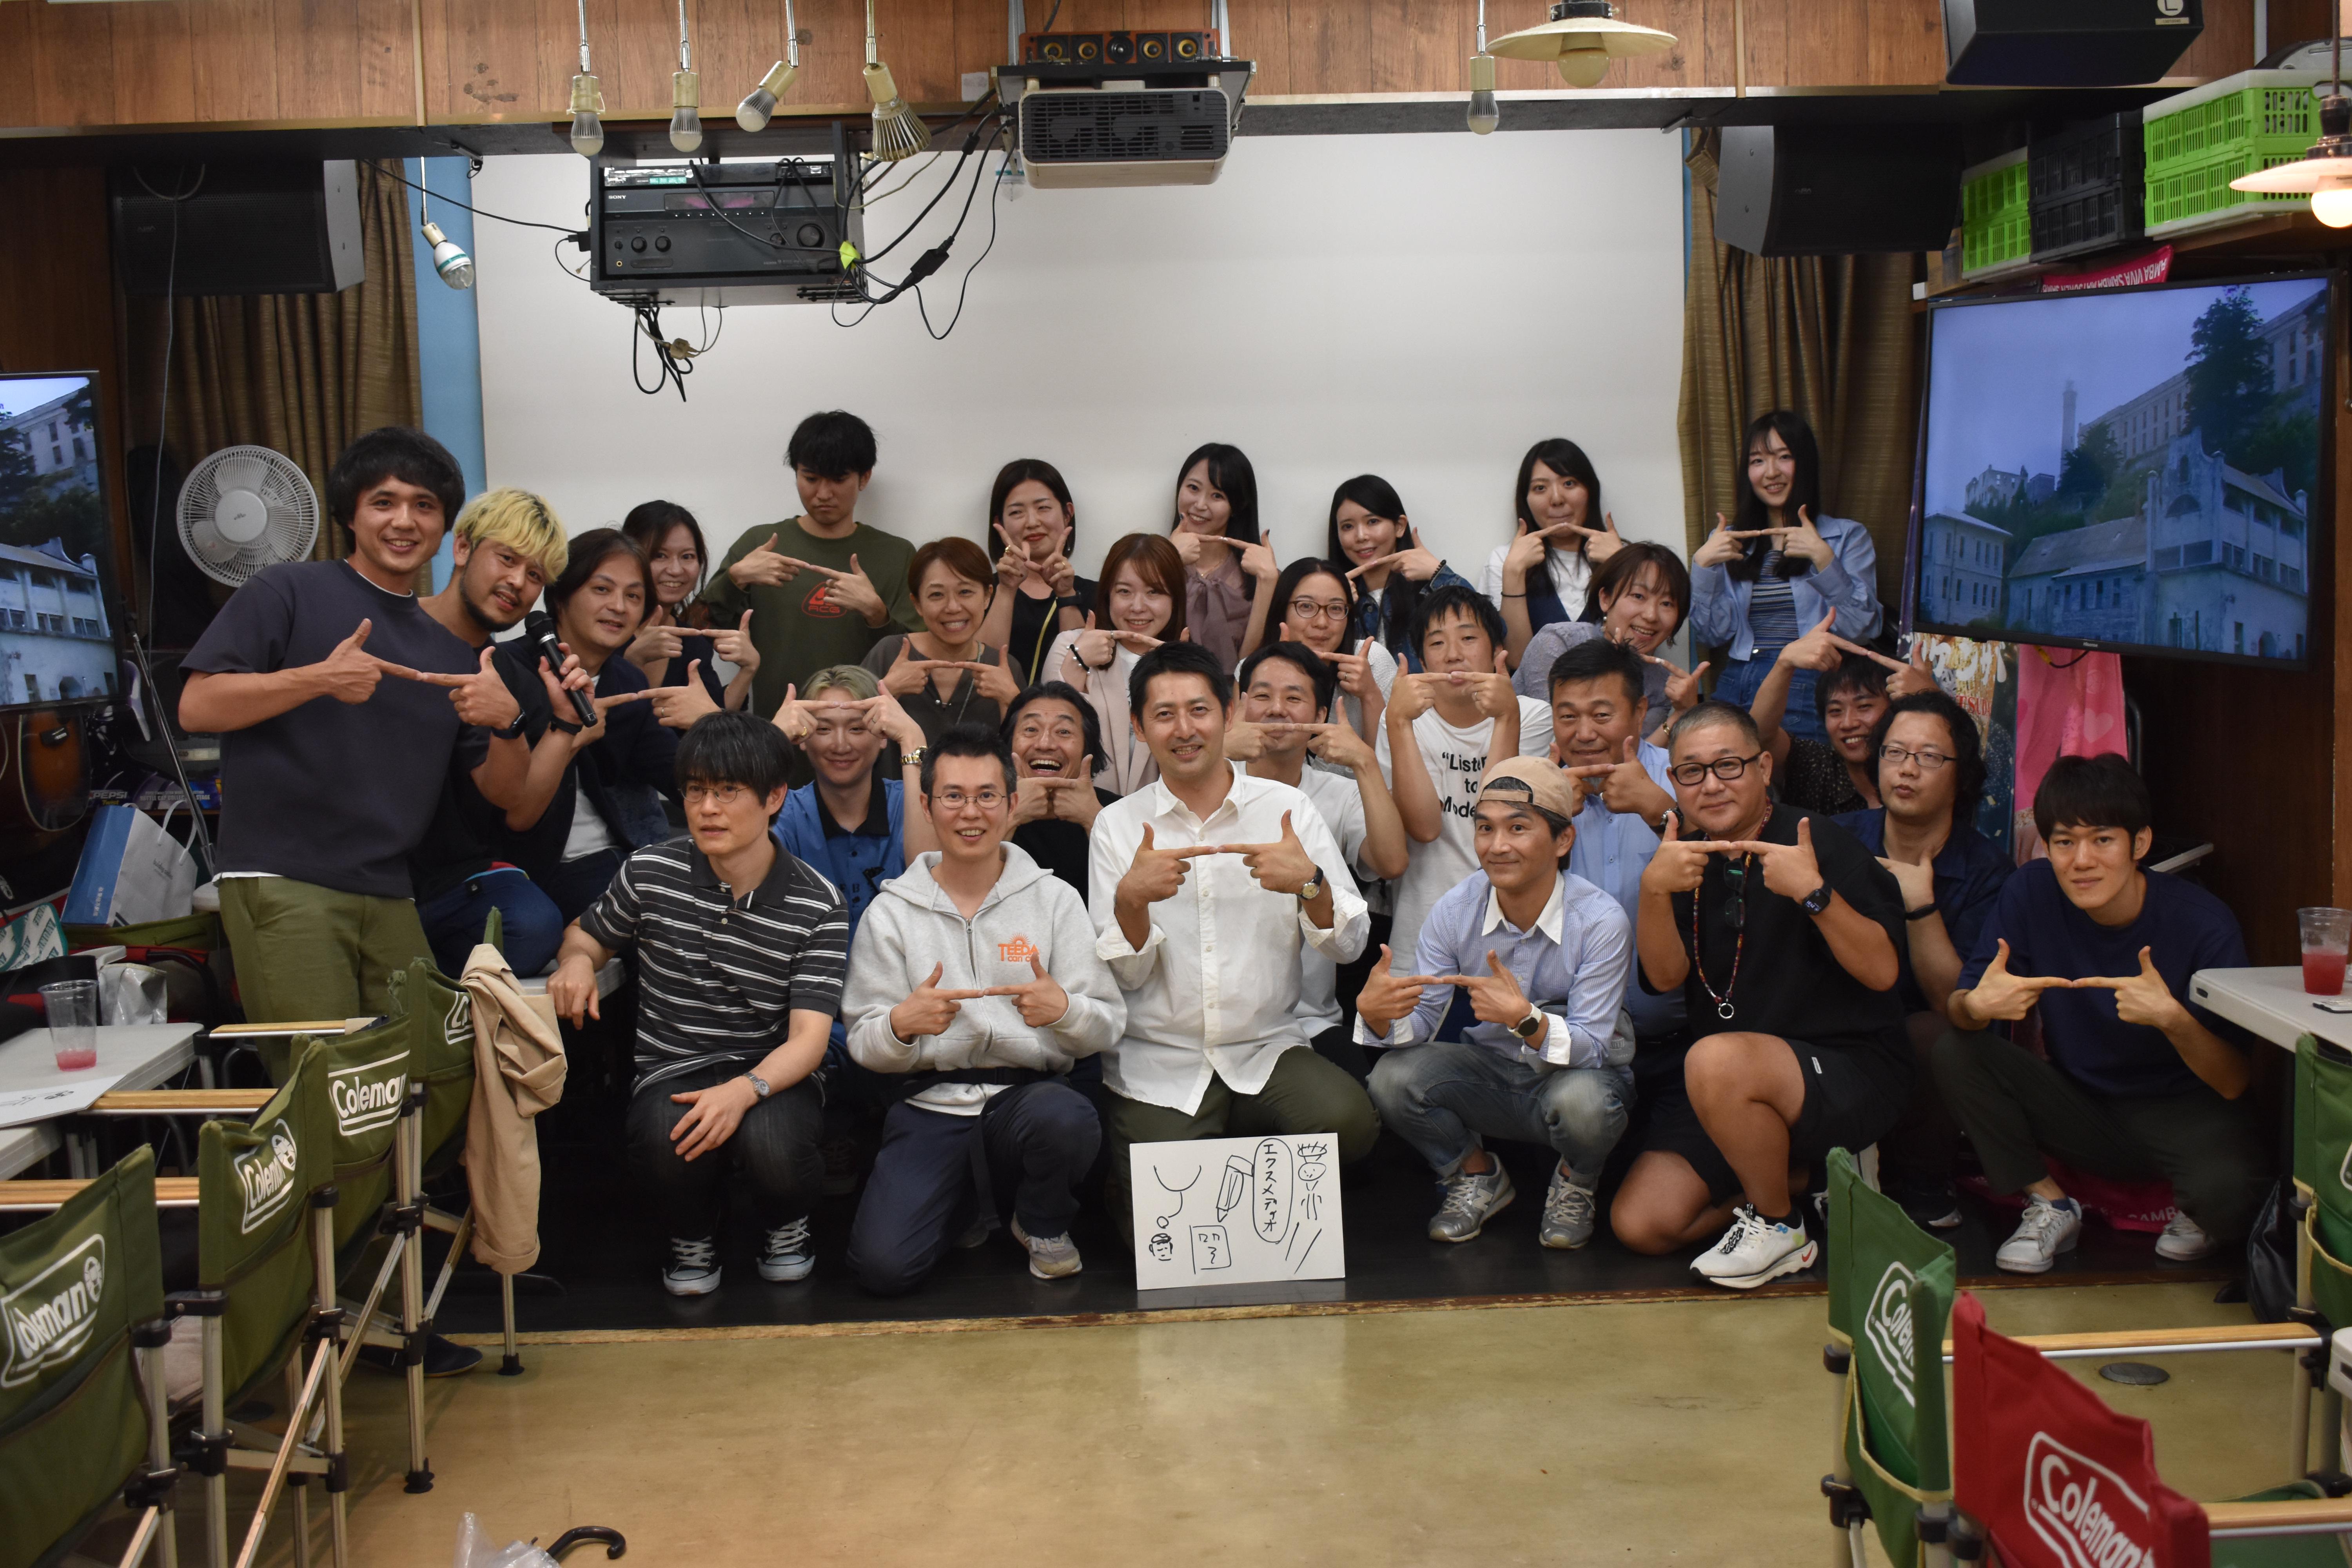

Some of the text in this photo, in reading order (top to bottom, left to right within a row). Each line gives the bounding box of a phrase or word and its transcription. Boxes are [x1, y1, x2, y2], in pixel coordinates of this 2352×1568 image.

[1464, 778, 1478, 793] to
[93, 791, 128, 799] PEPSI
[998, 943, 1040, 961] TEEDA
[333, 1073, 406, 1118] Coleman
[1262, 1144, 1278, 1232] エクスメディオ
[2128, 1206, 2177, 1221] AMB
